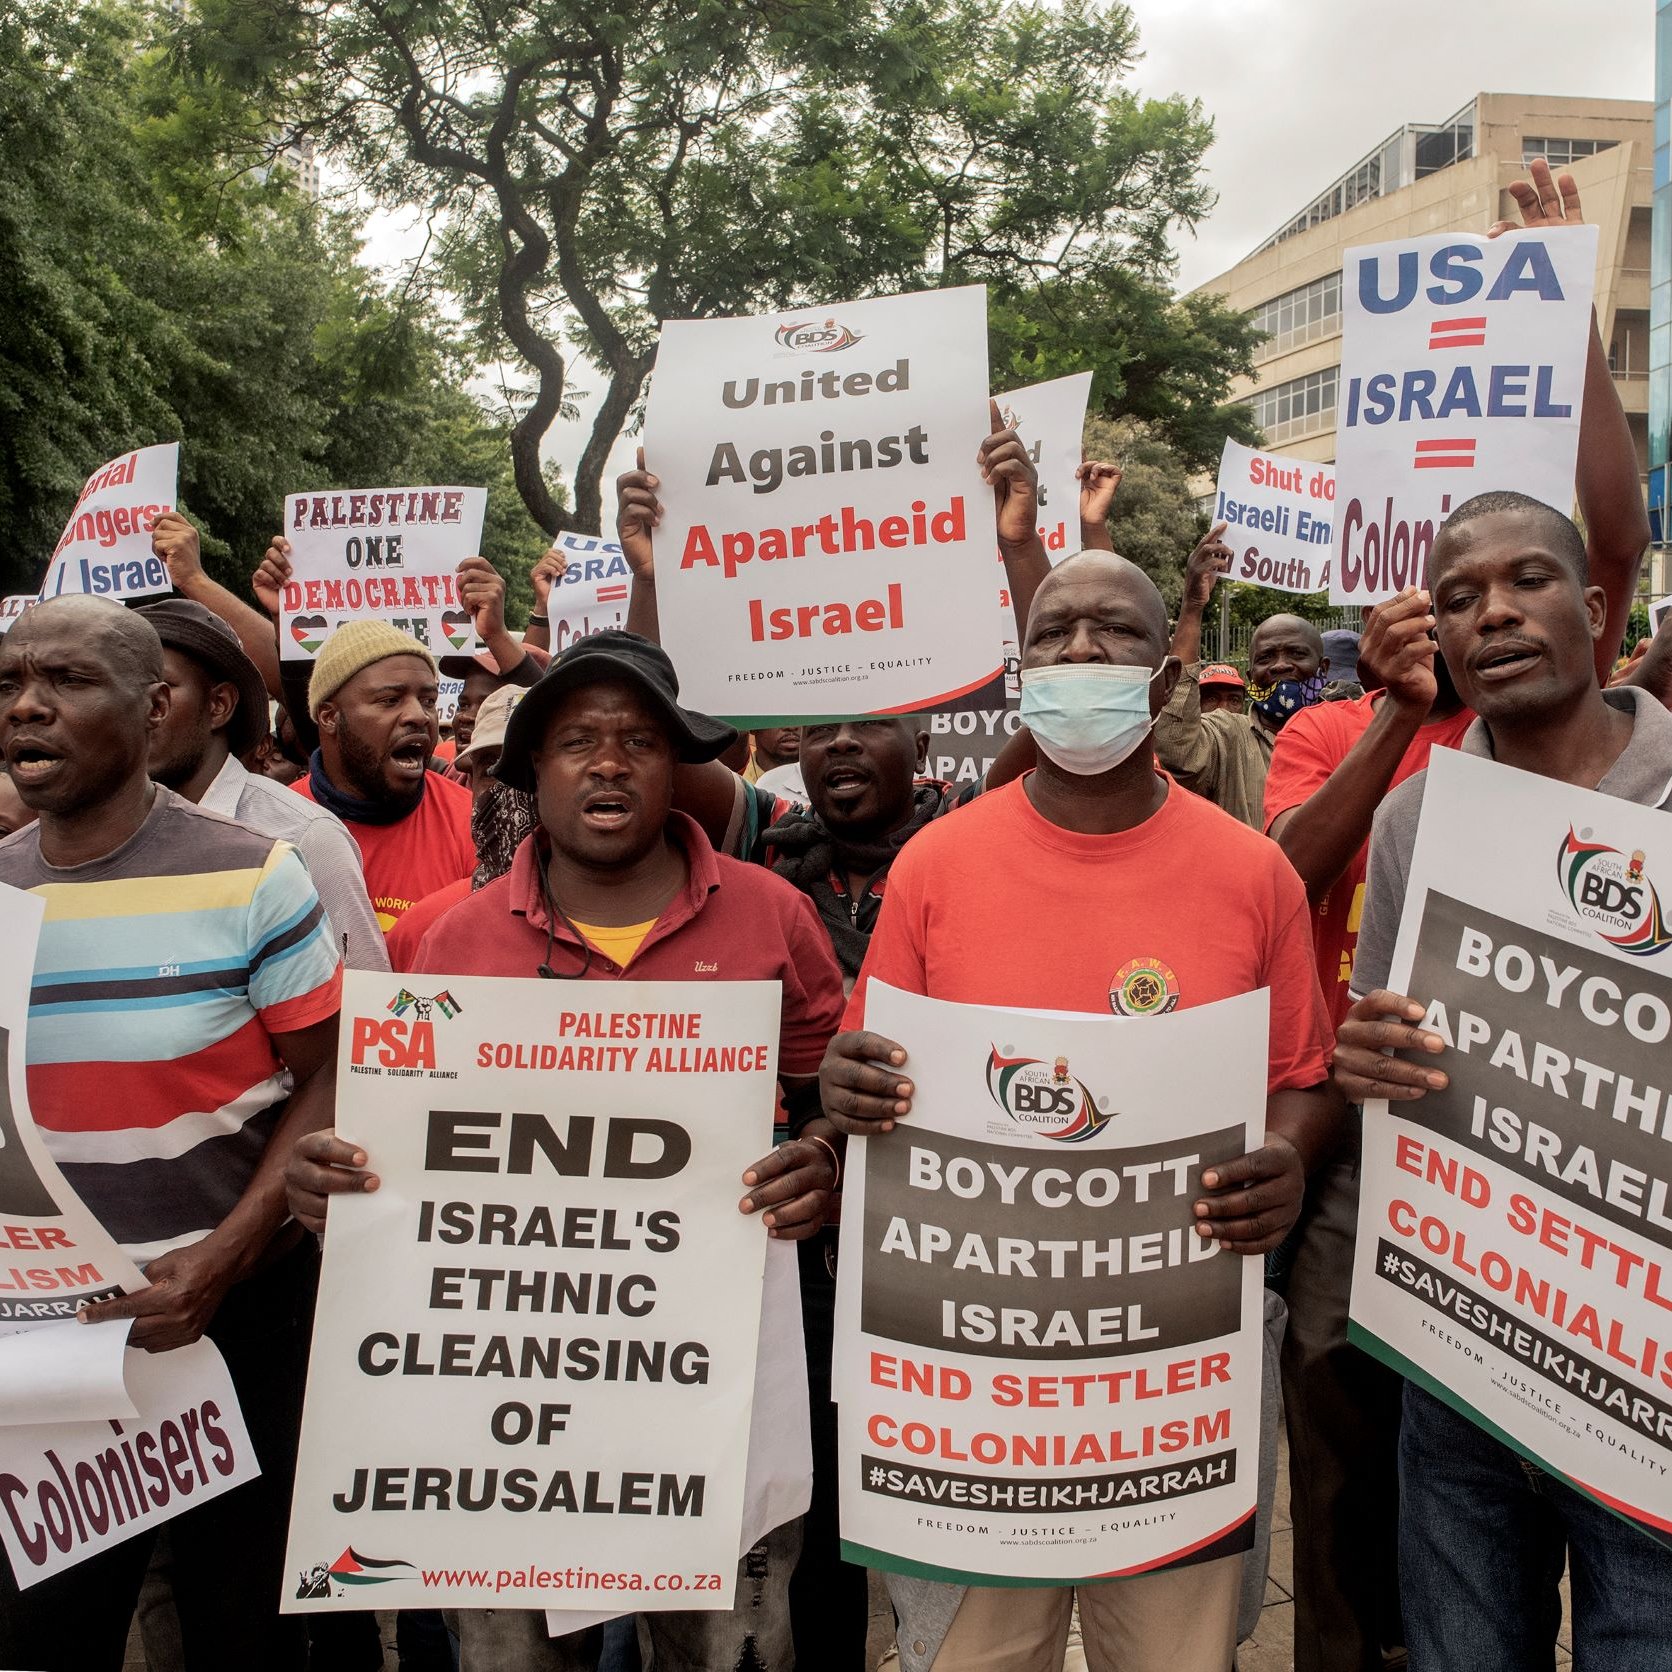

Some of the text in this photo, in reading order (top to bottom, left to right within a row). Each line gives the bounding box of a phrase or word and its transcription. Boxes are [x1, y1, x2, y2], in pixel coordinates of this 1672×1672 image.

[1359, 241, 1565, 314] USA
[795, 329, 838, 345] BDS
[722, 358, 909, 409] United
[1346, 365, 1572, 427] ISRAEL
[705, 425, 930, 494] Against
[1250, 457, 1302, 494] Shut
[294, 491, 464, 531] PALESTINE
[1217, 491, 1333, 545] Israeli Em
[346, 535, 404, 570] ONE
[680, 496, 966, 578] Apartheid
[1240, 546, 1310, 589] South
[749, 583, 904, 642] Israel
[728, 670, 784, 682] FREEDOM
[801, 665, 851, 676] JUSTICE
[870, 657, 932, 670] EQUALITY
[793, 674, 869, 686] www.sabdscoalition.org.za
[1580, 871, 1643, 919] BDS
[1582, 907, 1632, 930] COALITION
[351, 1017, 436, 1069] PSA
[558, 1011, 701, 1040] PALESTINE
[350, 1065, 458, 1079] PALESTINE SOLIDARITY ALLIANCE
[476, 1043, 768, 1073] SOLIDARITY ALLIANCE
[1019, 1076, 1050, 1084] AFRICAN
[1024, 1070, 1048, 1078] SOUTH
[1014, 1083, 1075, 1115] BDS
[1018, 1113, 1069, 1124] COALITION
[424, 1110, 692, 1180] END
[908, 1145, 1201, 1207] BOYCOTT
[1396, 1134, 1491, 1209] END
[416, 1200, 681, 1253] ISRAEL'S
[880, 1216, 1222, 1278] APARTHEID
[428, 1267, 657, 1317] ETHNIC
[942, 1299, 1160, 1347] ISRAEL
[357, 1331, 711, 1385] CLEANSING
[870, 1351, 1232, 1407] END SETTLER
[1421, 1319, 1484, 1365] FREEDOM
[1502, 1372, 1562, 1414] JUSTICE
[1585, 1423, 1667, 1475] EQUALITY
[1490, 1377, 1581, 1438] www.sabdscoalition.org.za
[490, 1401, 571, 1446] OF
[867, 1408, 1231, 1466] COLONIALISM
[0, 1399, 236, 1567] Colonisers
[332, 1467, 706, 1518] JERUSALEM
[869, 1459, 1228, 1507] #SAVESHEIKHJARRAH
[917, 1517, 989, 1534] FREEDOM
[1011, 1526, 1075, 1536] JUSTICE
[1101, 1512, 1177, 1532] EQUALITY
[999, 1537, 1098, 1547] www.sabdscoalition.org.za
[421, 1564, 722, 1593] www.palestinesa.co.za
